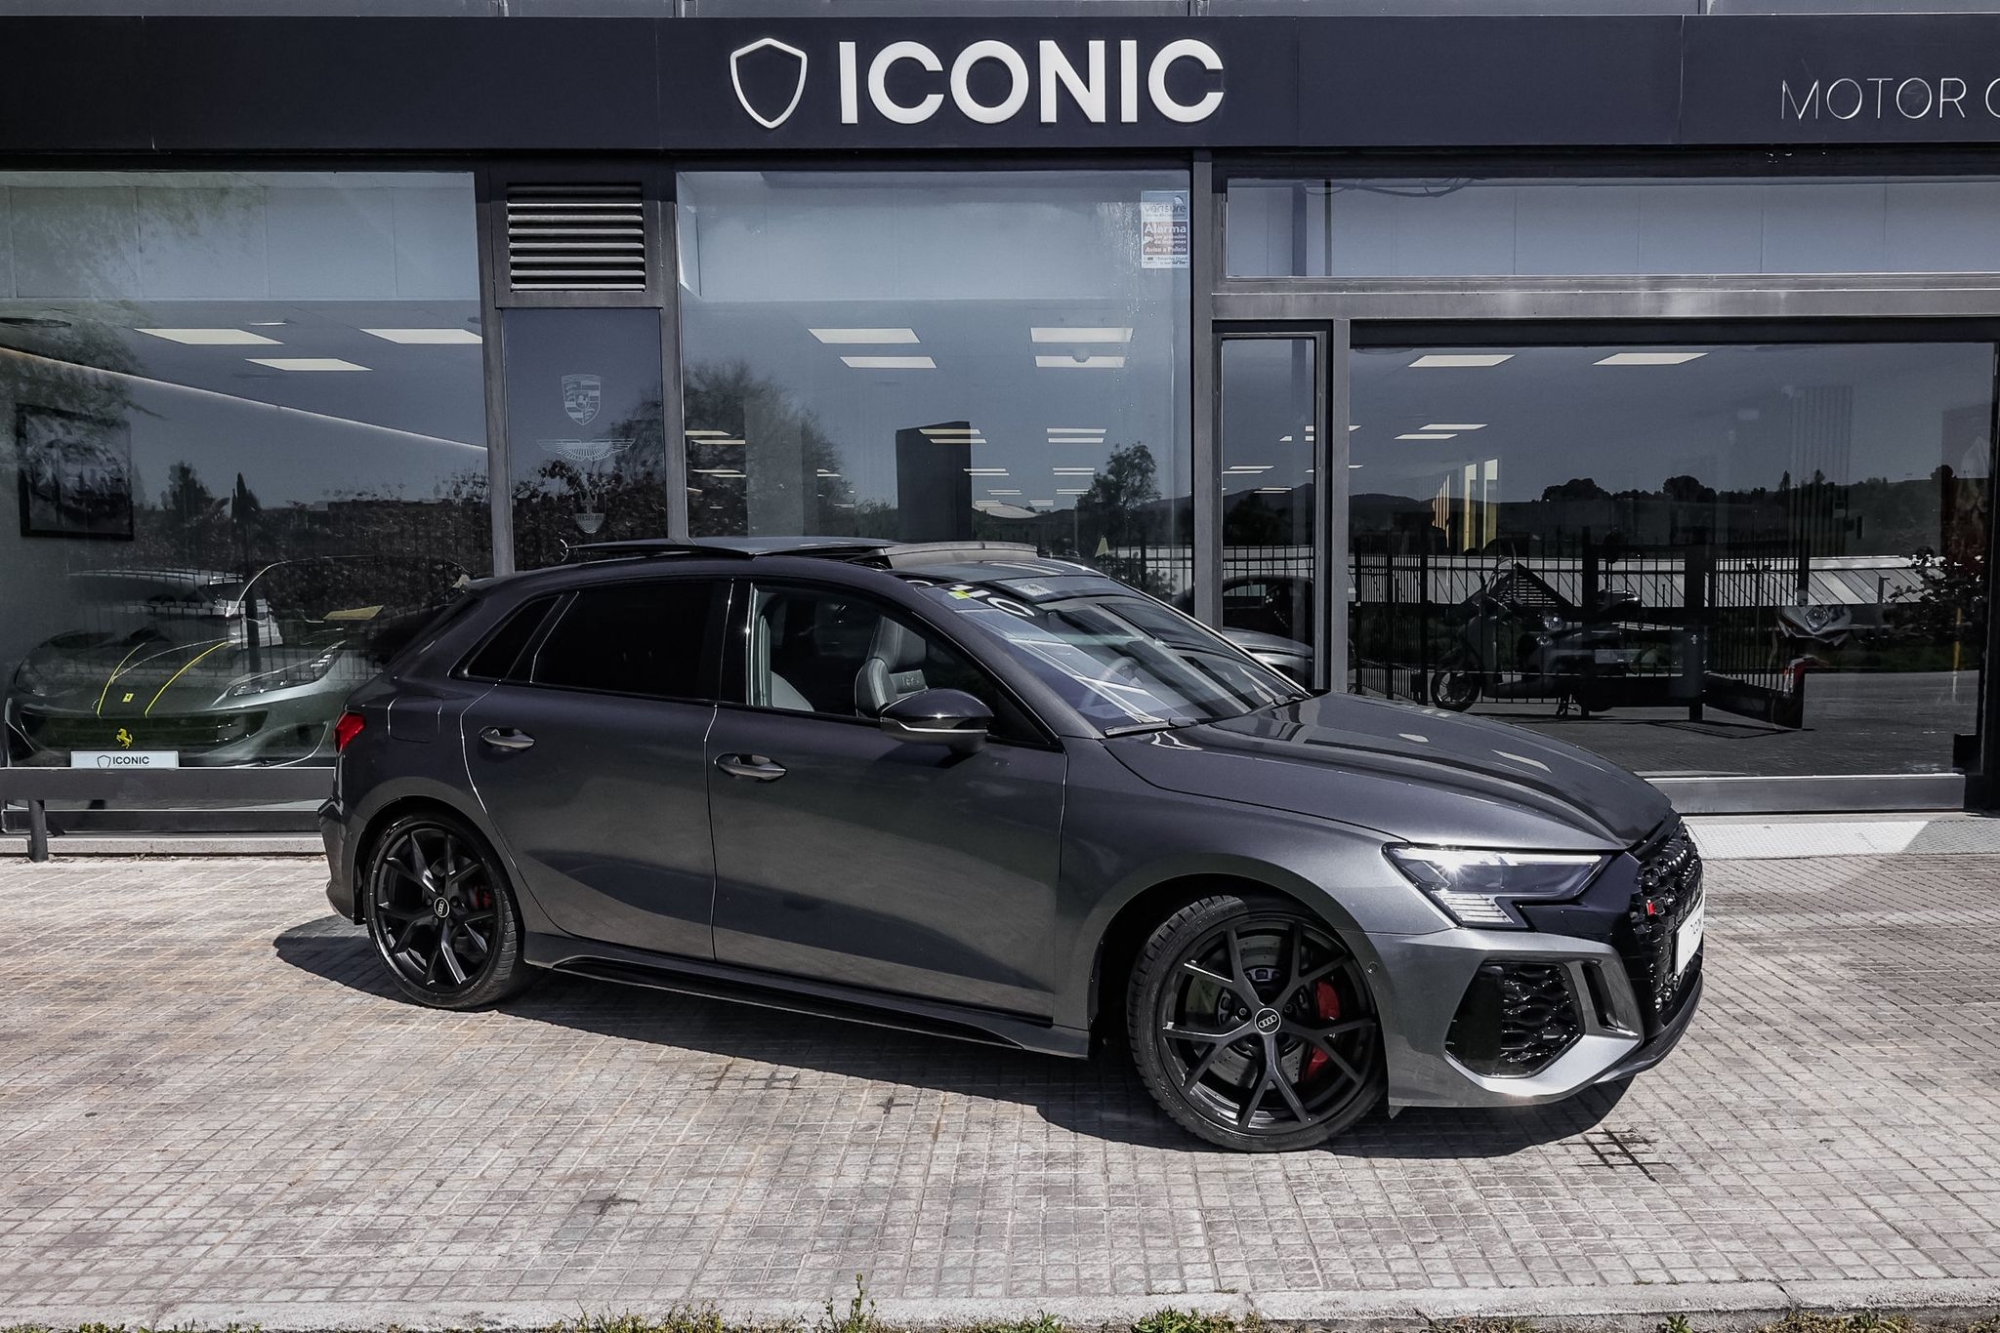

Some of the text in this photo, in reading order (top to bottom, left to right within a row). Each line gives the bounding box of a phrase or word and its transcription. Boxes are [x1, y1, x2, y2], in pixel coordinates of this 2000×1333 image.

[838, 38, 1225, 125] ICONIC
[1781, 77, 1967, 120] MOTOR
[1144, 224, 1187, 233] Alarma
[113, 756, 150, 764] ICONIC
